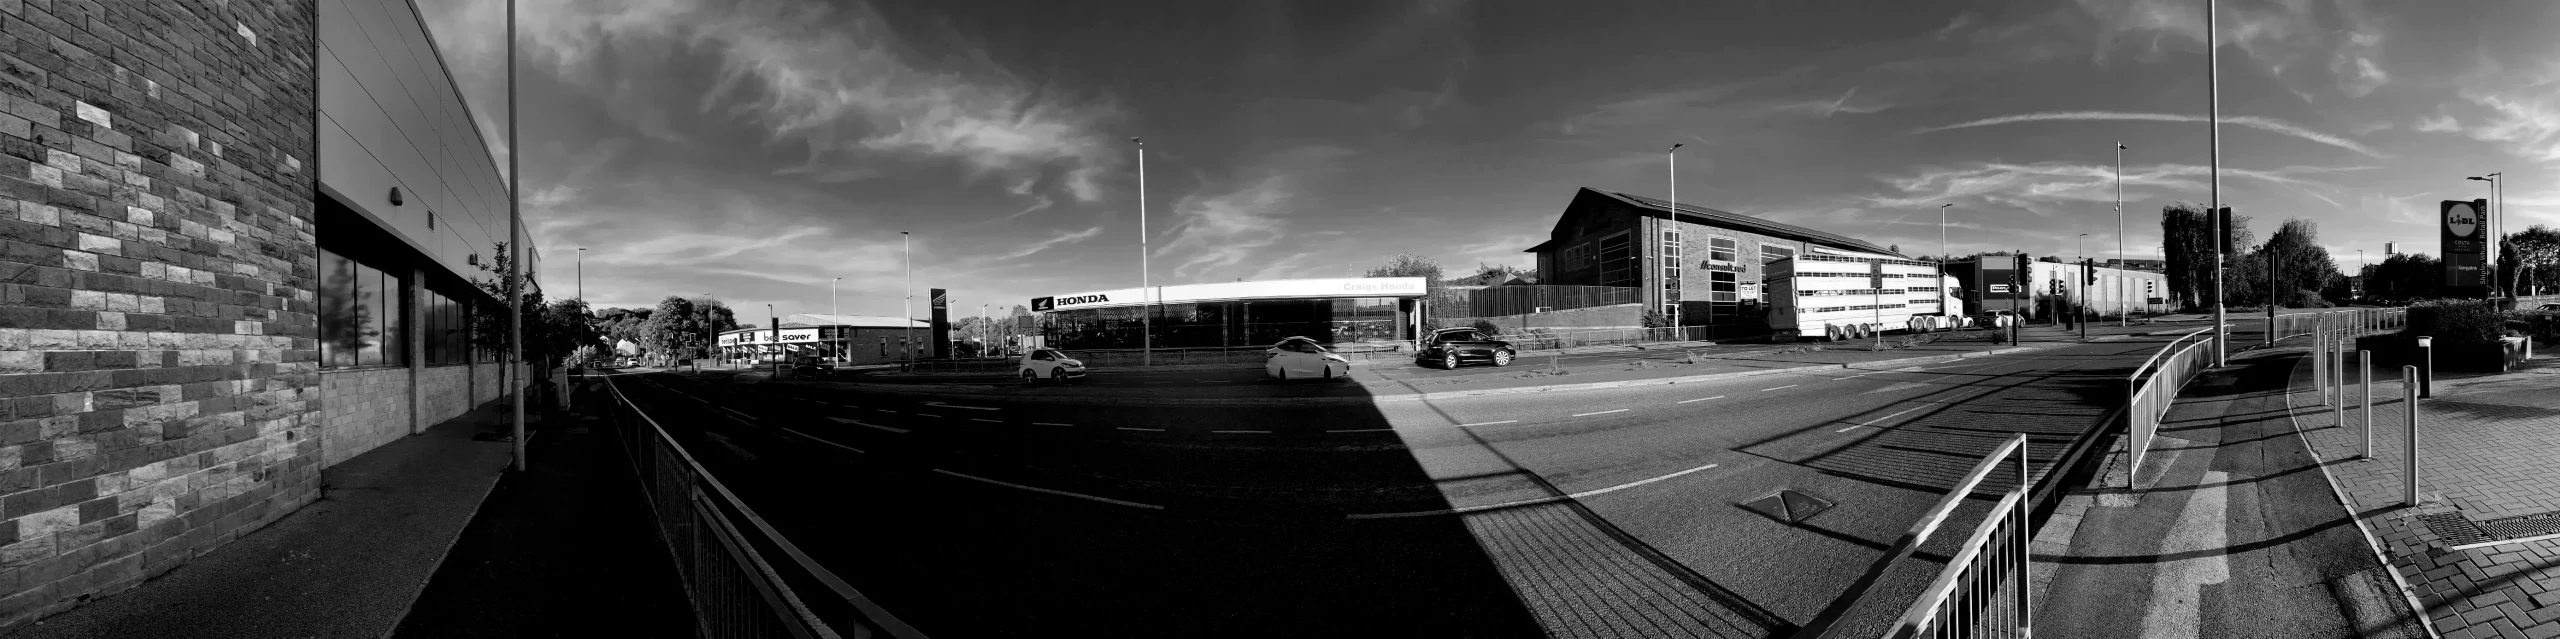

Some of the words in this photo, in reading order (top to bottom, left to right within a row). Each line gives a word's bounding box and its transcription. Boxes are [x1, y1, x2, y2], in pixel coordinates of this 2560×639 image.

[1343, 282, 1378, 292] Craigs
[1380, 282, 1415, 291] Honda
[1056, 294, 1110, 306] HONDA
[782, 333, 812, 341] saver
